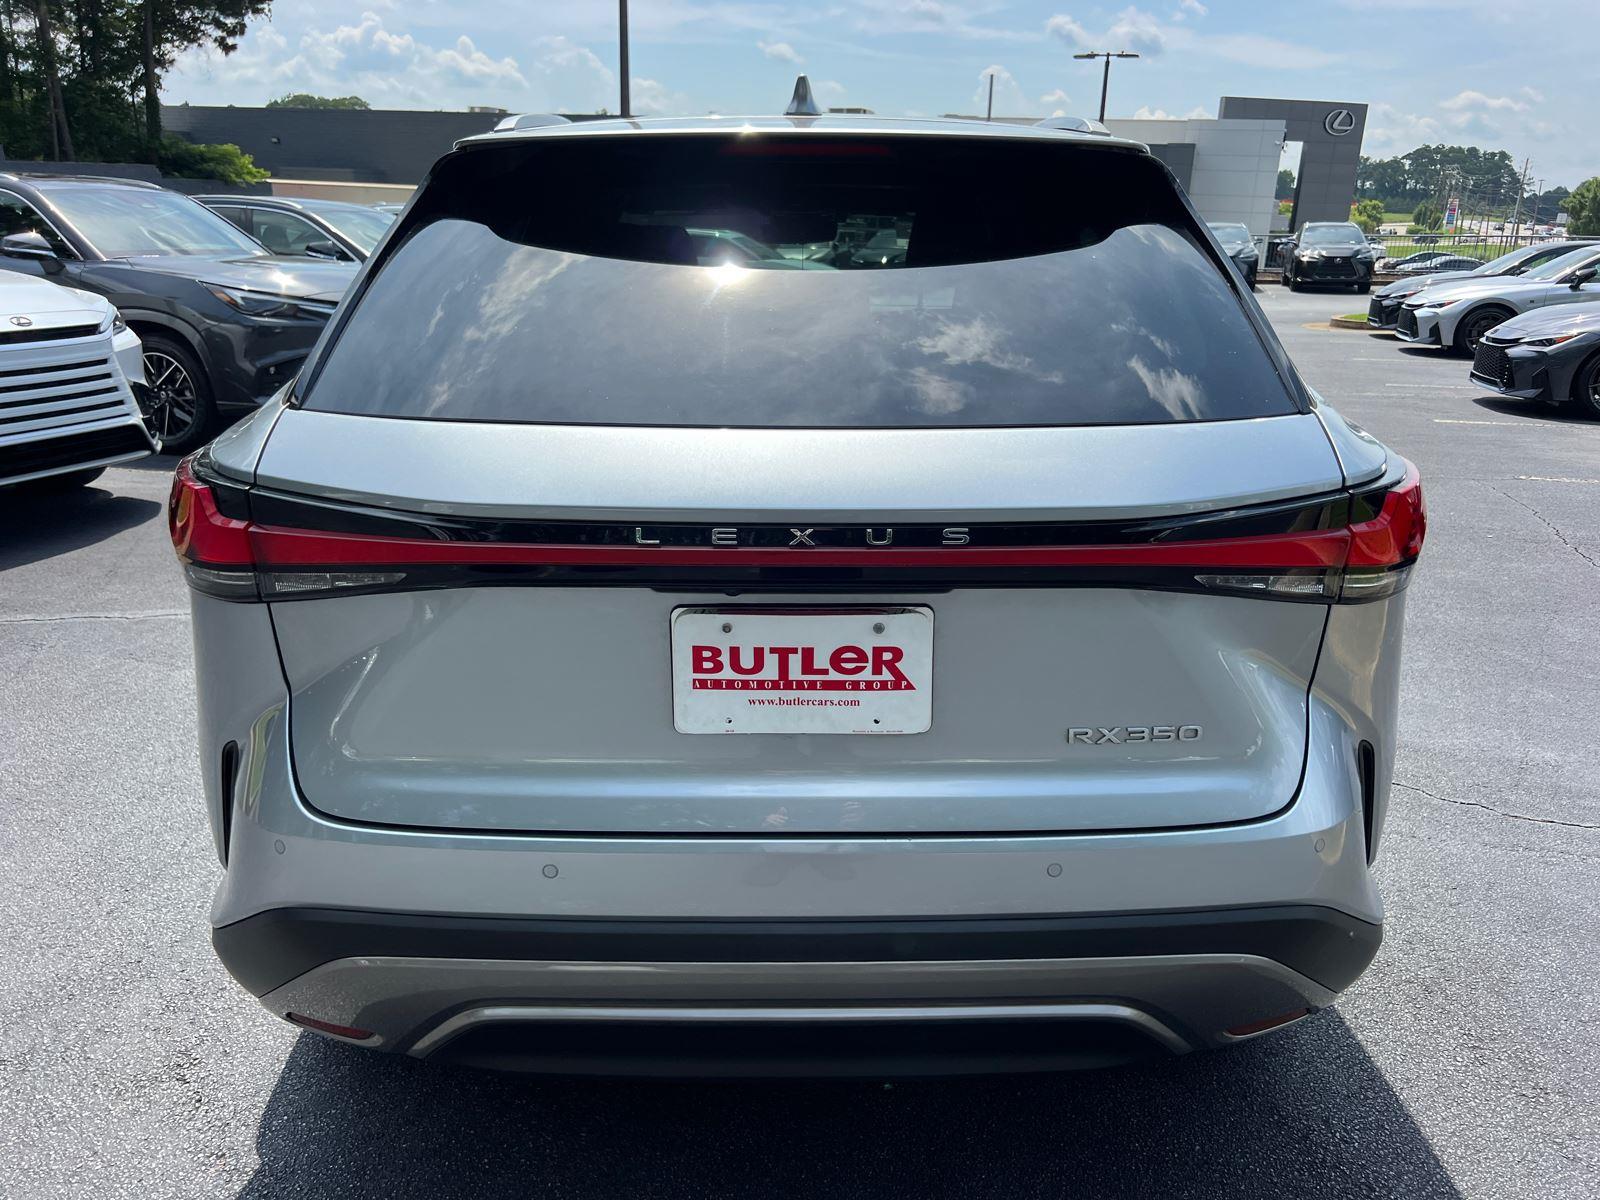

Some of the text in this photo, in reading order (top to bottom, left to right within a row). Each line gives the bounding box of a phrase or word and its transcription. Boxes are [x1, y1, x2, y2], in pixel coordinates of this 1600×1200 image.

[635, 527, 970, 546] LEXUS
[693, 679, 908, 690] AUTOMOTIVE GROUP
[748, 697, 860, 707] www.butlercars.com
[1067, 724, 1204, 745] RX350
